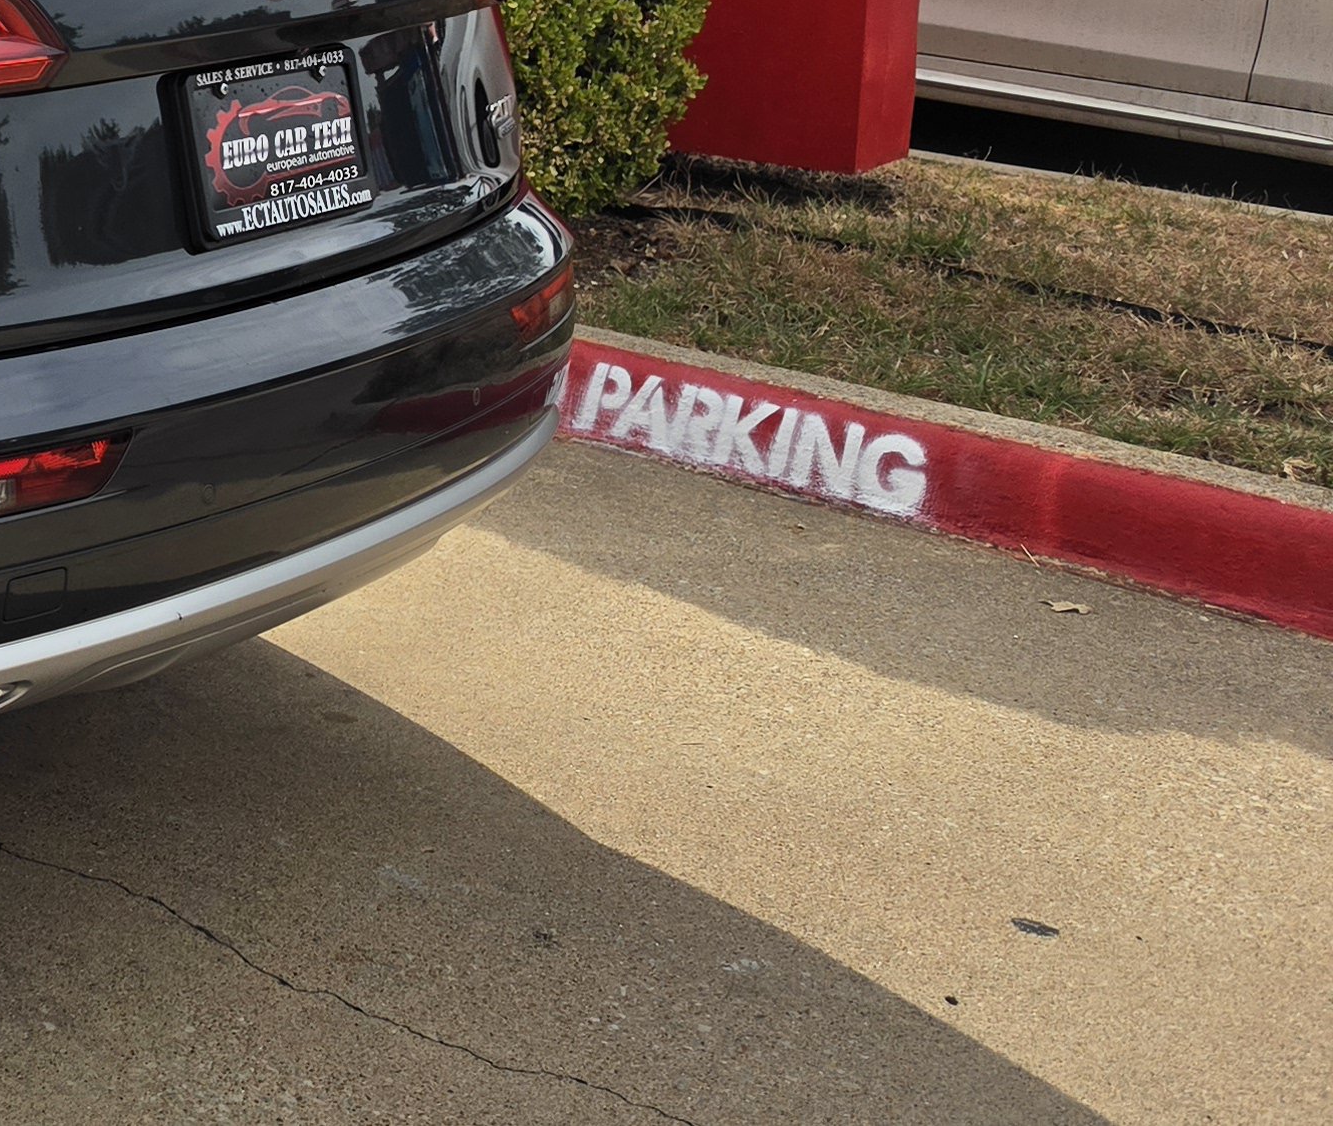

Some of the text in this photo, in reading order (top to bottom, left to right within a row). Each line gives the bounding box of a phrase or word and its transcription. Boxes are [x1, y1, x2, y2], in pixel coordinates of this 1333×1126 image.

[197, 51, 344, 87] SALES & SERVICE 817-404-4033
[222, 117, 352, 171] EURO CAR TECH
[267, 145, 356, 172] european automotive
[271, 166, 359, 196] 817-404-4033
[216, 184, 372, 238] www.ECTAUTOSALES.com
[571, 361, 927, 518] PARKING
